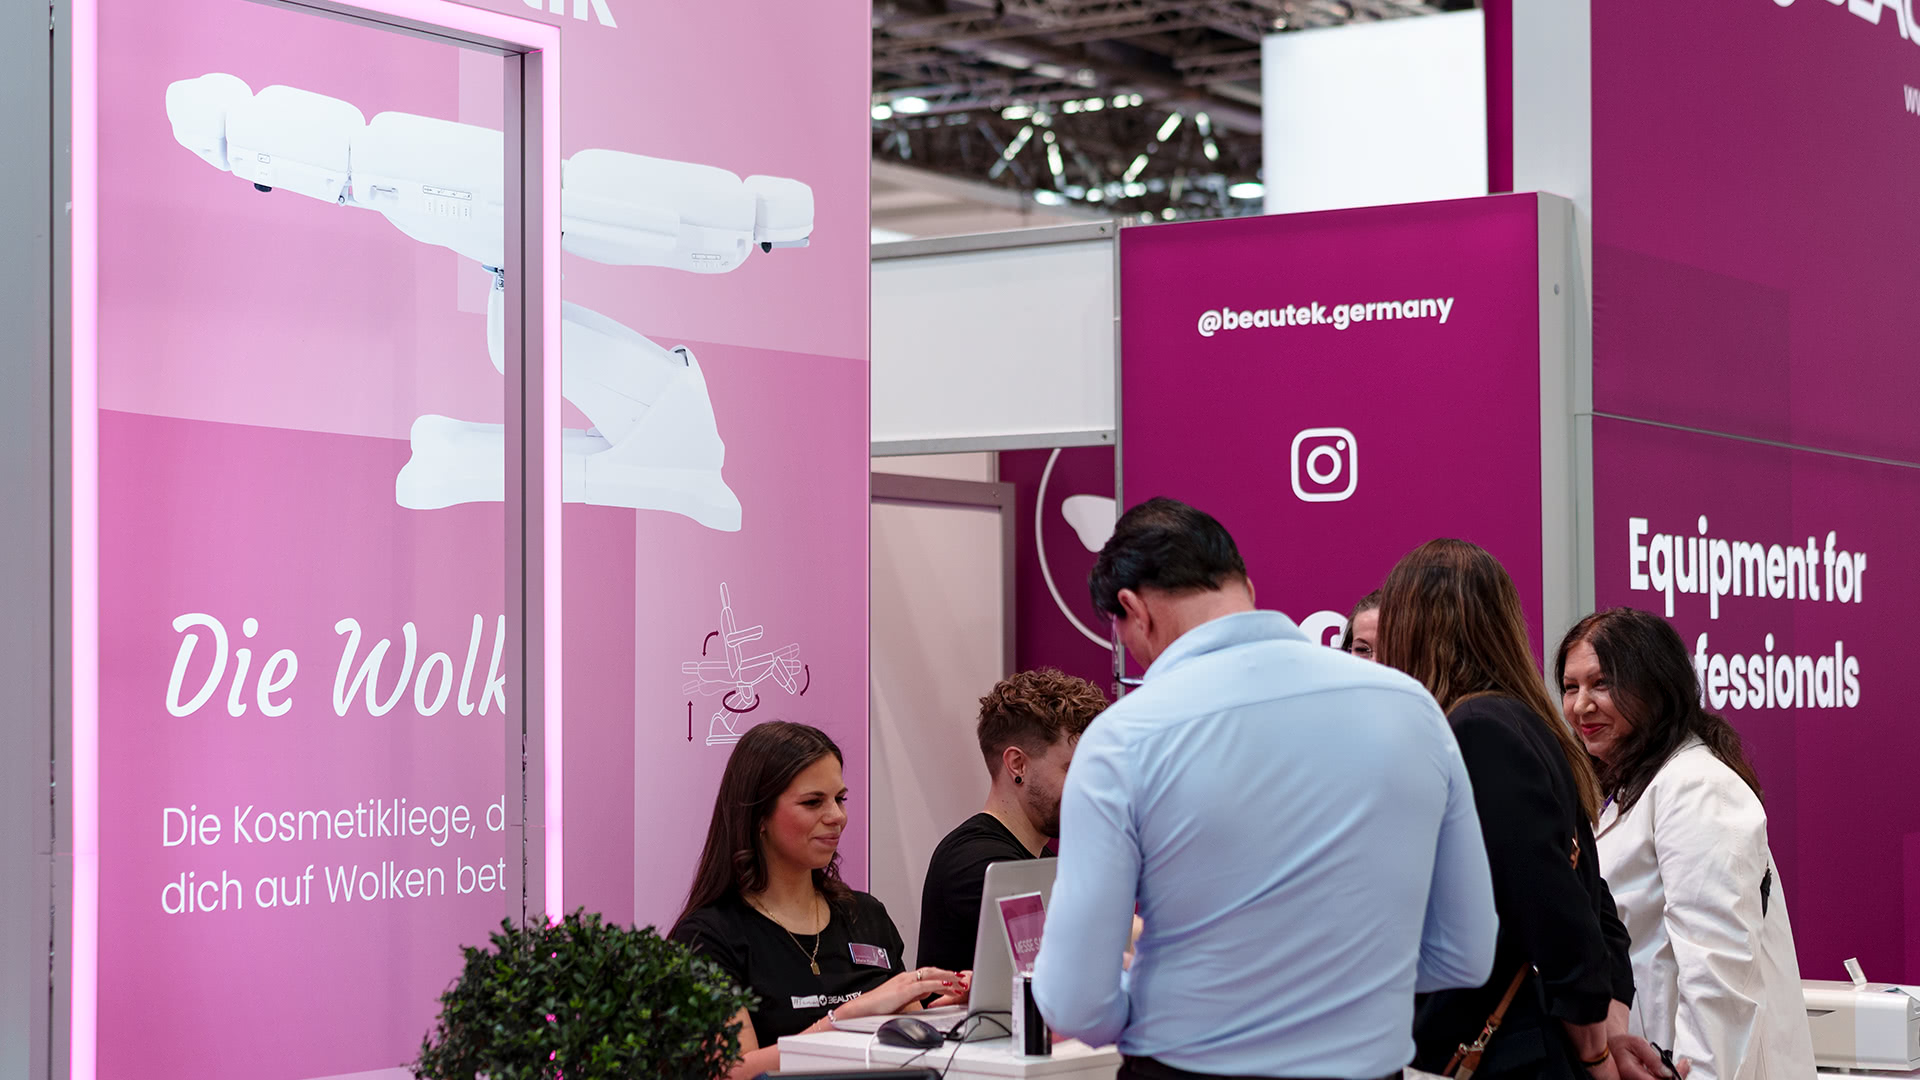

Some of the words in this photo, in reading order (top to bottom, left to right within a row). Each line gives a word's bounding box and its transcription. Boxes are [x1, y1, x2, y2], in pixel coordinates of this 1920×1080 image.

[1198, 297, 1454, 337] @beautek.germany
[1629, 515, 1820, 619] Equipment
[1824, 530, 1867, 603] for
[166, 613, 298, 717] Die
[333, 614, 505, 717] Wolk
[1694, 632, 1860, 710] fessionals
[163, 804, 221, 847] Die
[234, 798, 476, 847] Kosmetikliege,
[486, 794, 505, 832] d
[161, 869, 242, 914] dich
[255, 864, 314, 908] auf
[325, 860, 445, 903] Wolken
[457, 856, 506, 894] bet
